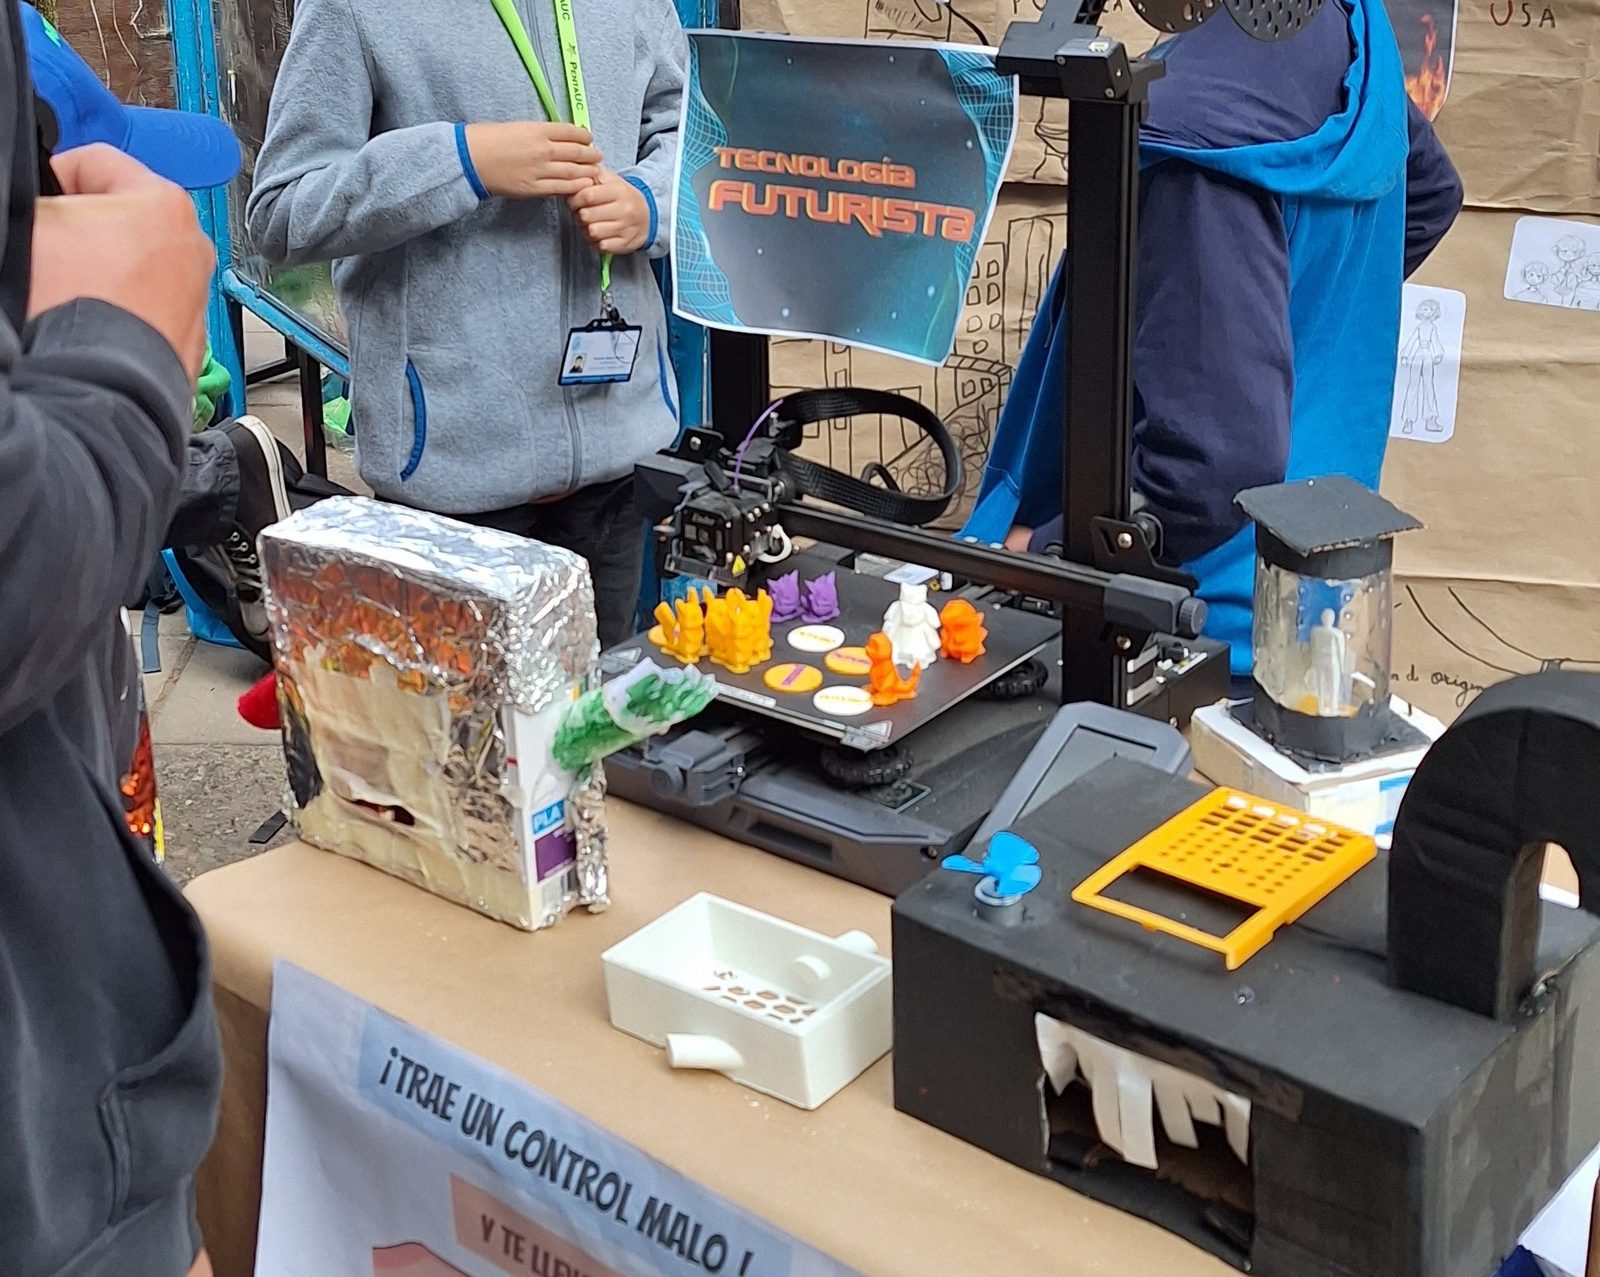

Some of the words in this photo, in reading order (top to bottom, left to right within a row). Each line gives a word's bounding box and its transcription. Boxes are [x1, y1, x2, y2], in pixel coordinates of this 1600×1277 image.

[1490, 0, 1556, 28] USA
[379, 1047, 462, 1121] ¡TRAE
[461, 1093, 505, 1146] UN
[504, 1120, 633, 1224] CONTROL
[637, 1196, 729, 1273] MALO
[501, 1225, 526, 1264] TE
